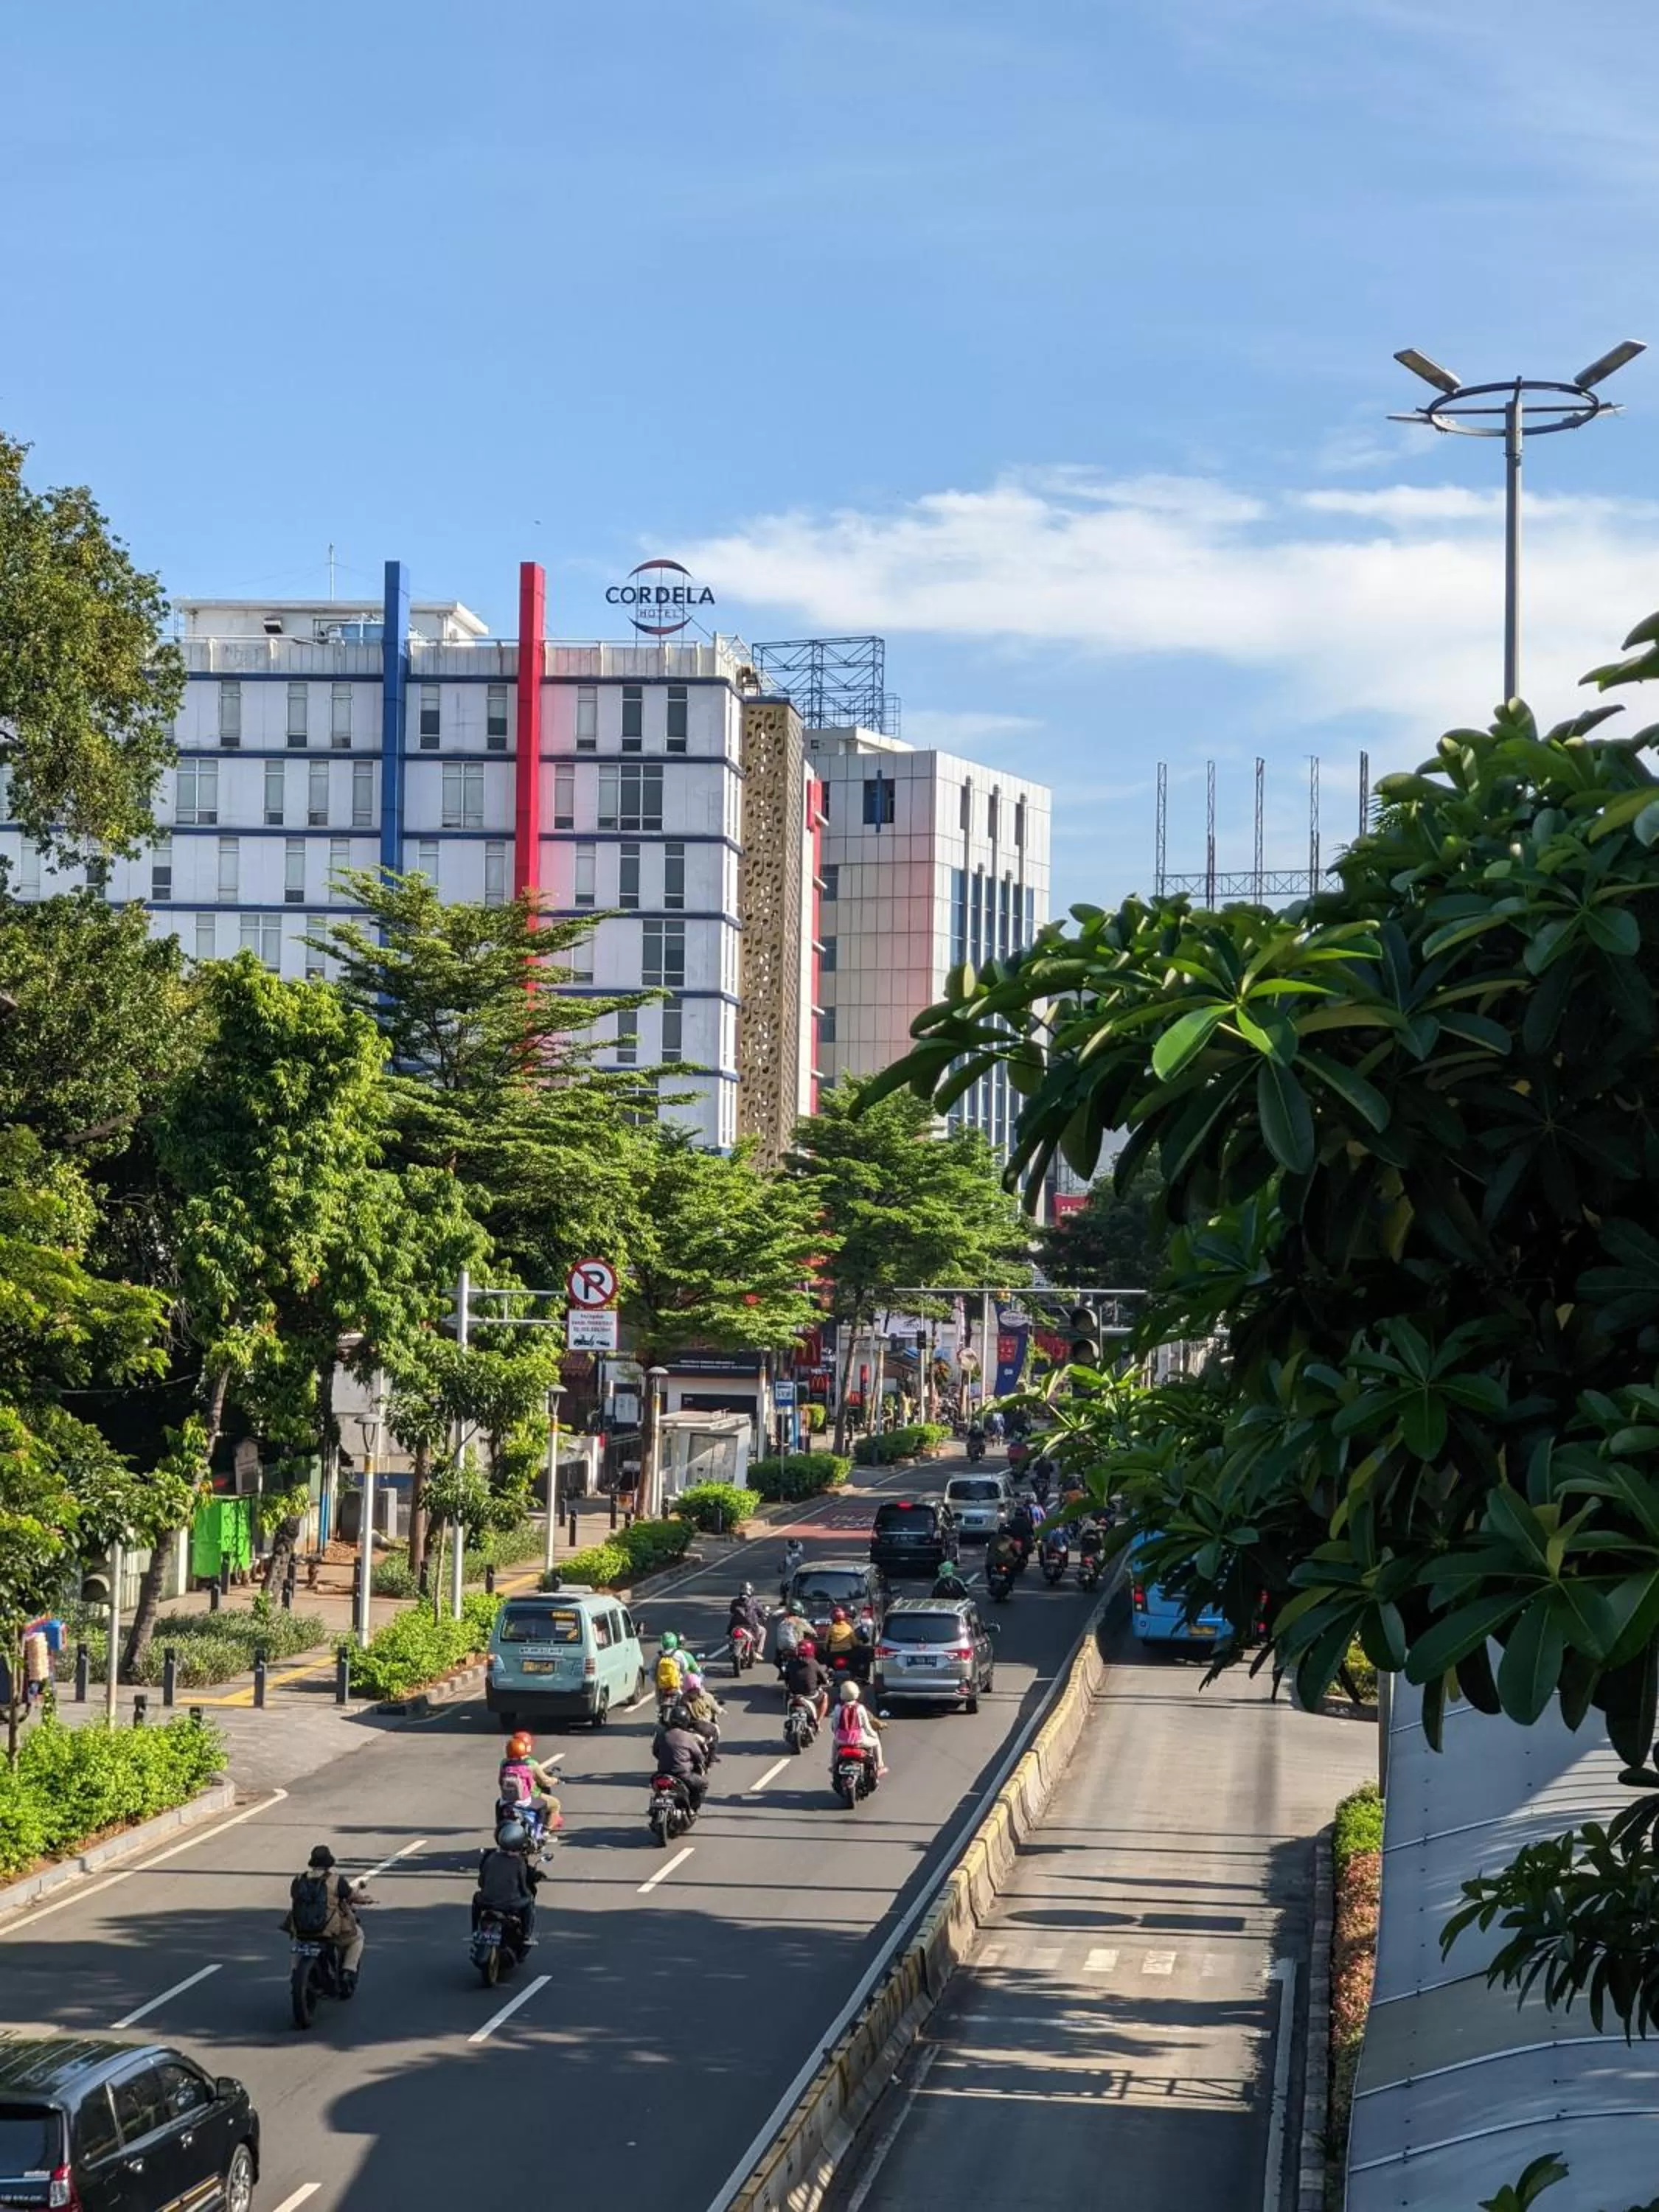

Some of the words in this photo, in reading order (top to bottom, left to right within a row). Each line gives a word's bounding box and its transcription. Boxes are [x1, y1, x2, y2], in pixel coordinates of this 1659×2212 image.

[605, 586, 715, 604] CORDELA
[639, 609, 680, 619] HOTEL
[582, 1270, 605, 1299] P
